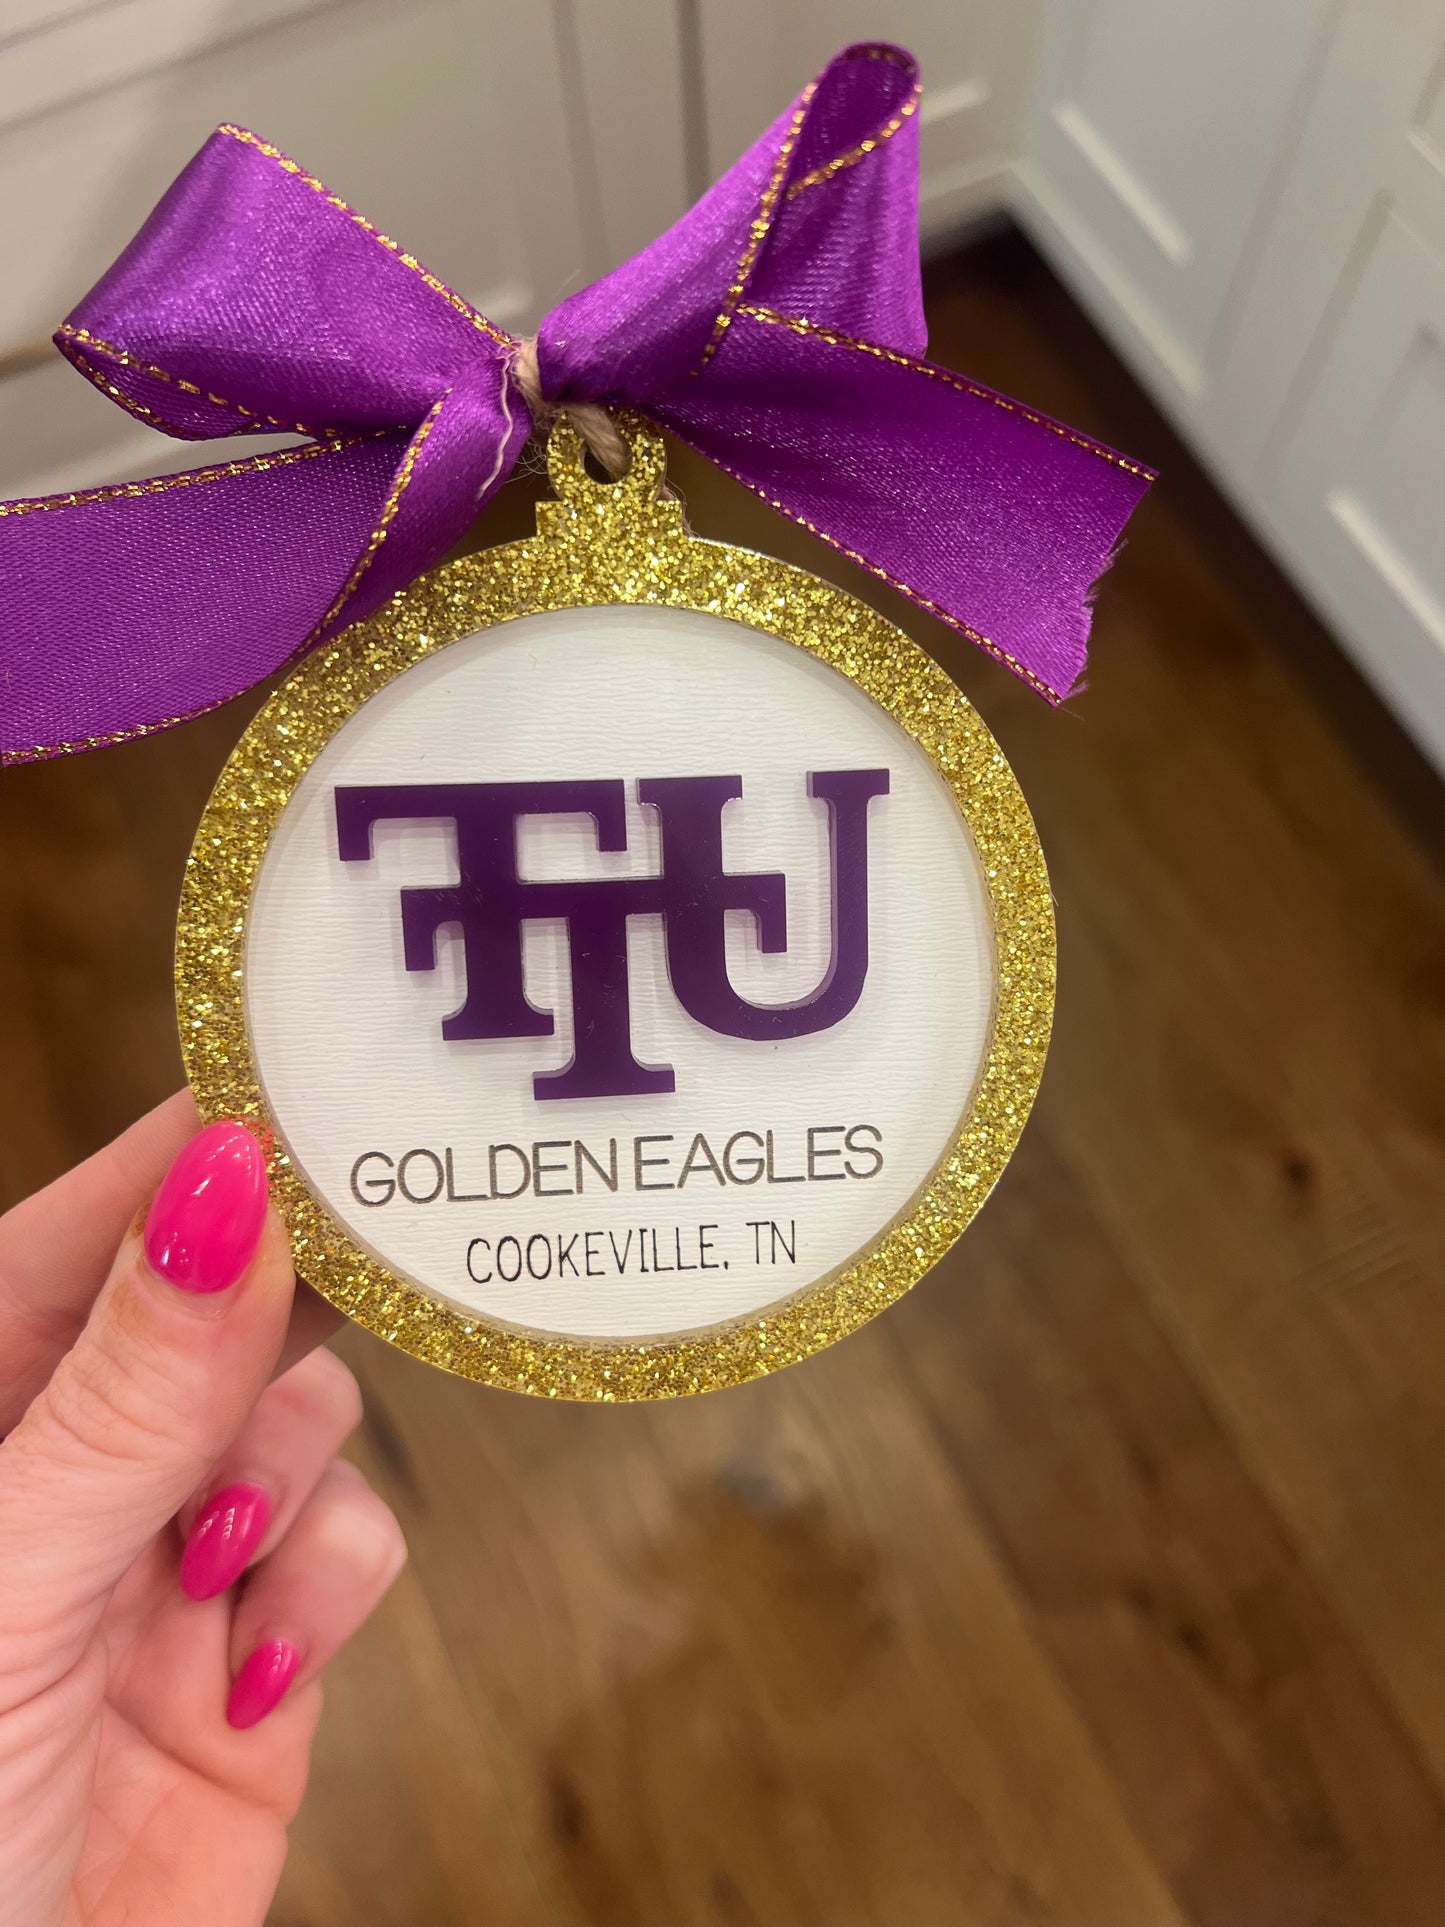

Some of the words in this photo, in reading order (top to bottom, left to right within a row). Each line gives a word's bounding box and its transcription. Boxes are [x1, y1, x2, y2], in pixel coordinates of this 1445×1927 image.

[334, 768, 890, 1101] TTU
[350, 1137, 619, 1208] GOLDEN
[633, 1124, 884, 1192] EAGLES
[745, 1220, 797, 1265] TN
